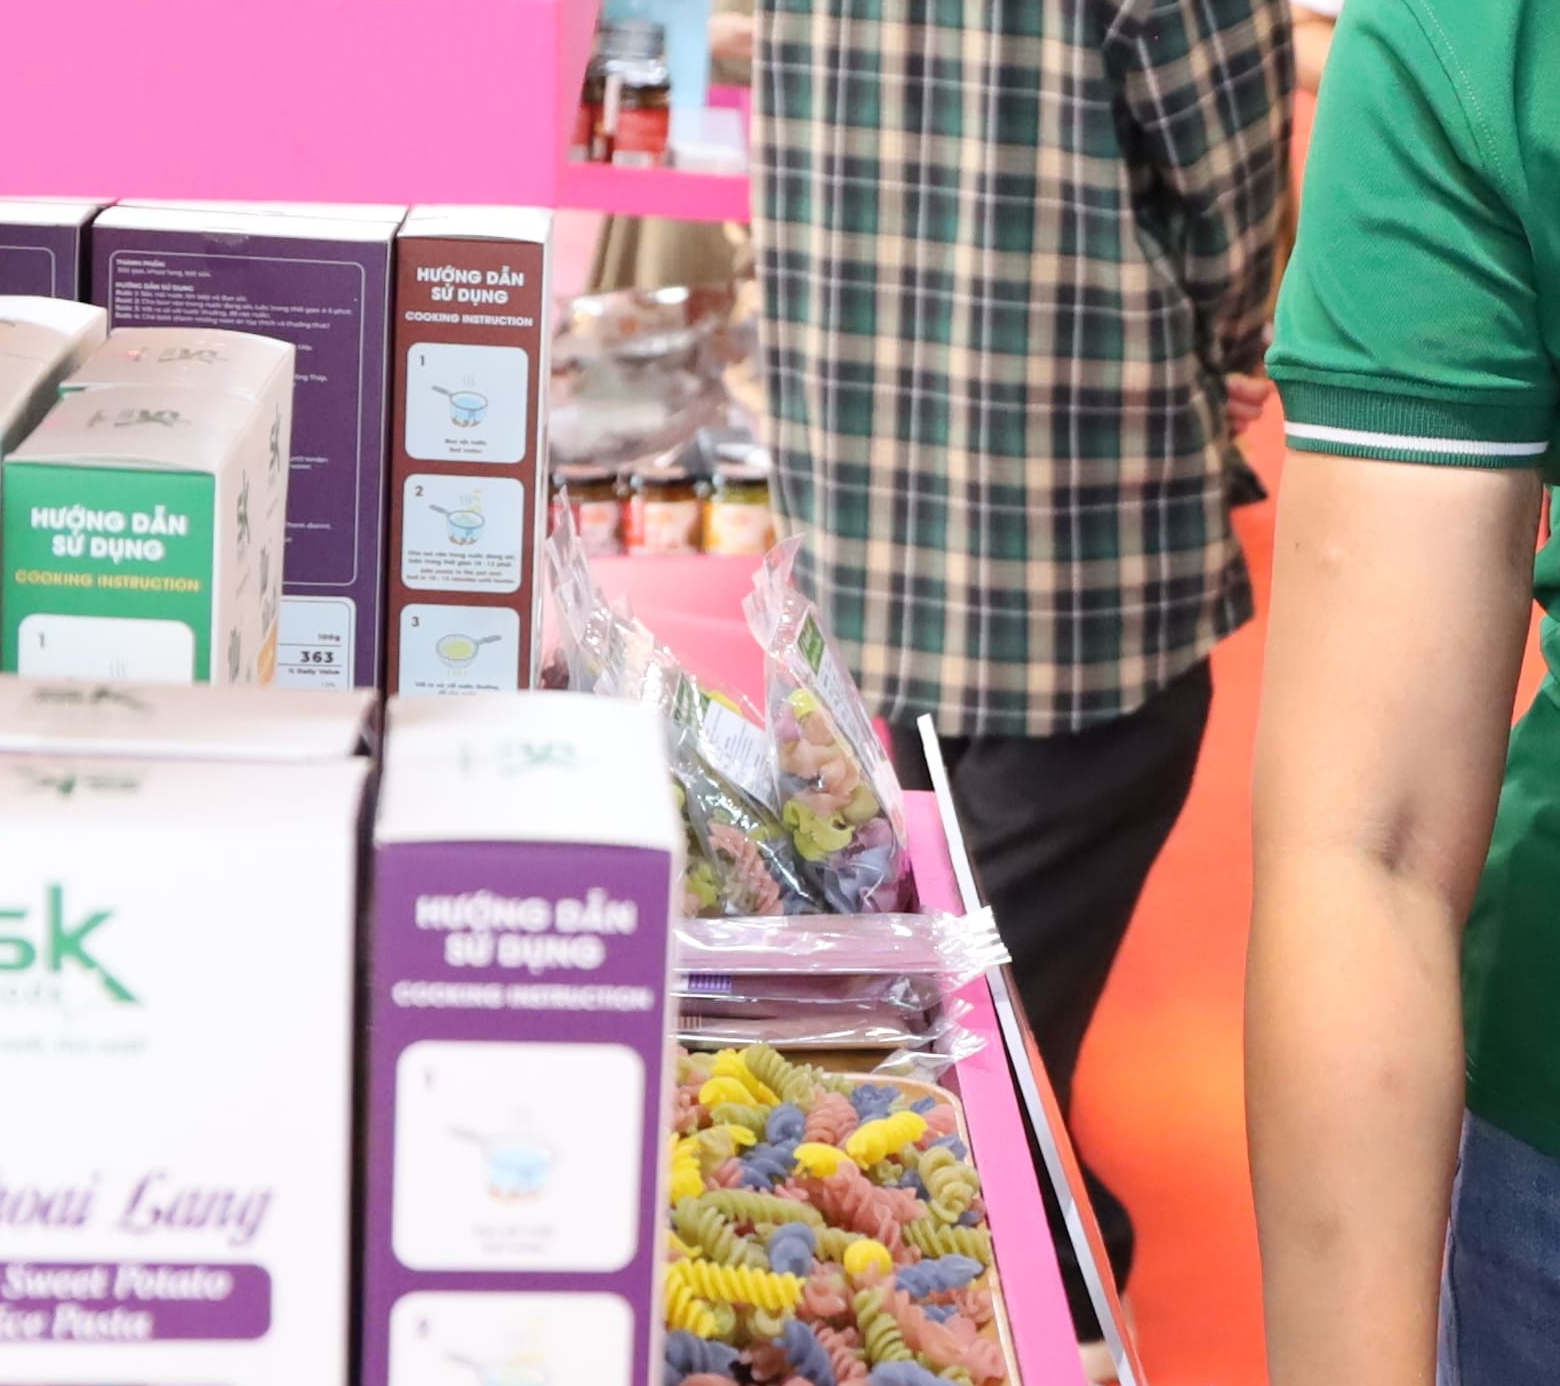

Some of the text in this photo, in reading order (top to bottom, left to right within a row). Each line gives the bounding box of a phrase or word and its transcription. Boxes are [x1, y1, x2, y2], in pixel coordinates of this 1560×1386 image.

[405, 311, 533, 327] COOKING INSTRUCTION
[419, 355, 426, 366] 1
[415, 485, 424, 497] 2
[15, 569, 202, 593] COOKING INSTRUCTION
[411, 616, 420, 627] 3
[300, 650, 335, 664] 363
[1, 1263, 108, 1302] Sweet
[113, 1263, 233, 1303] Potato
[50, 1304, 153, 1340] Pasta
